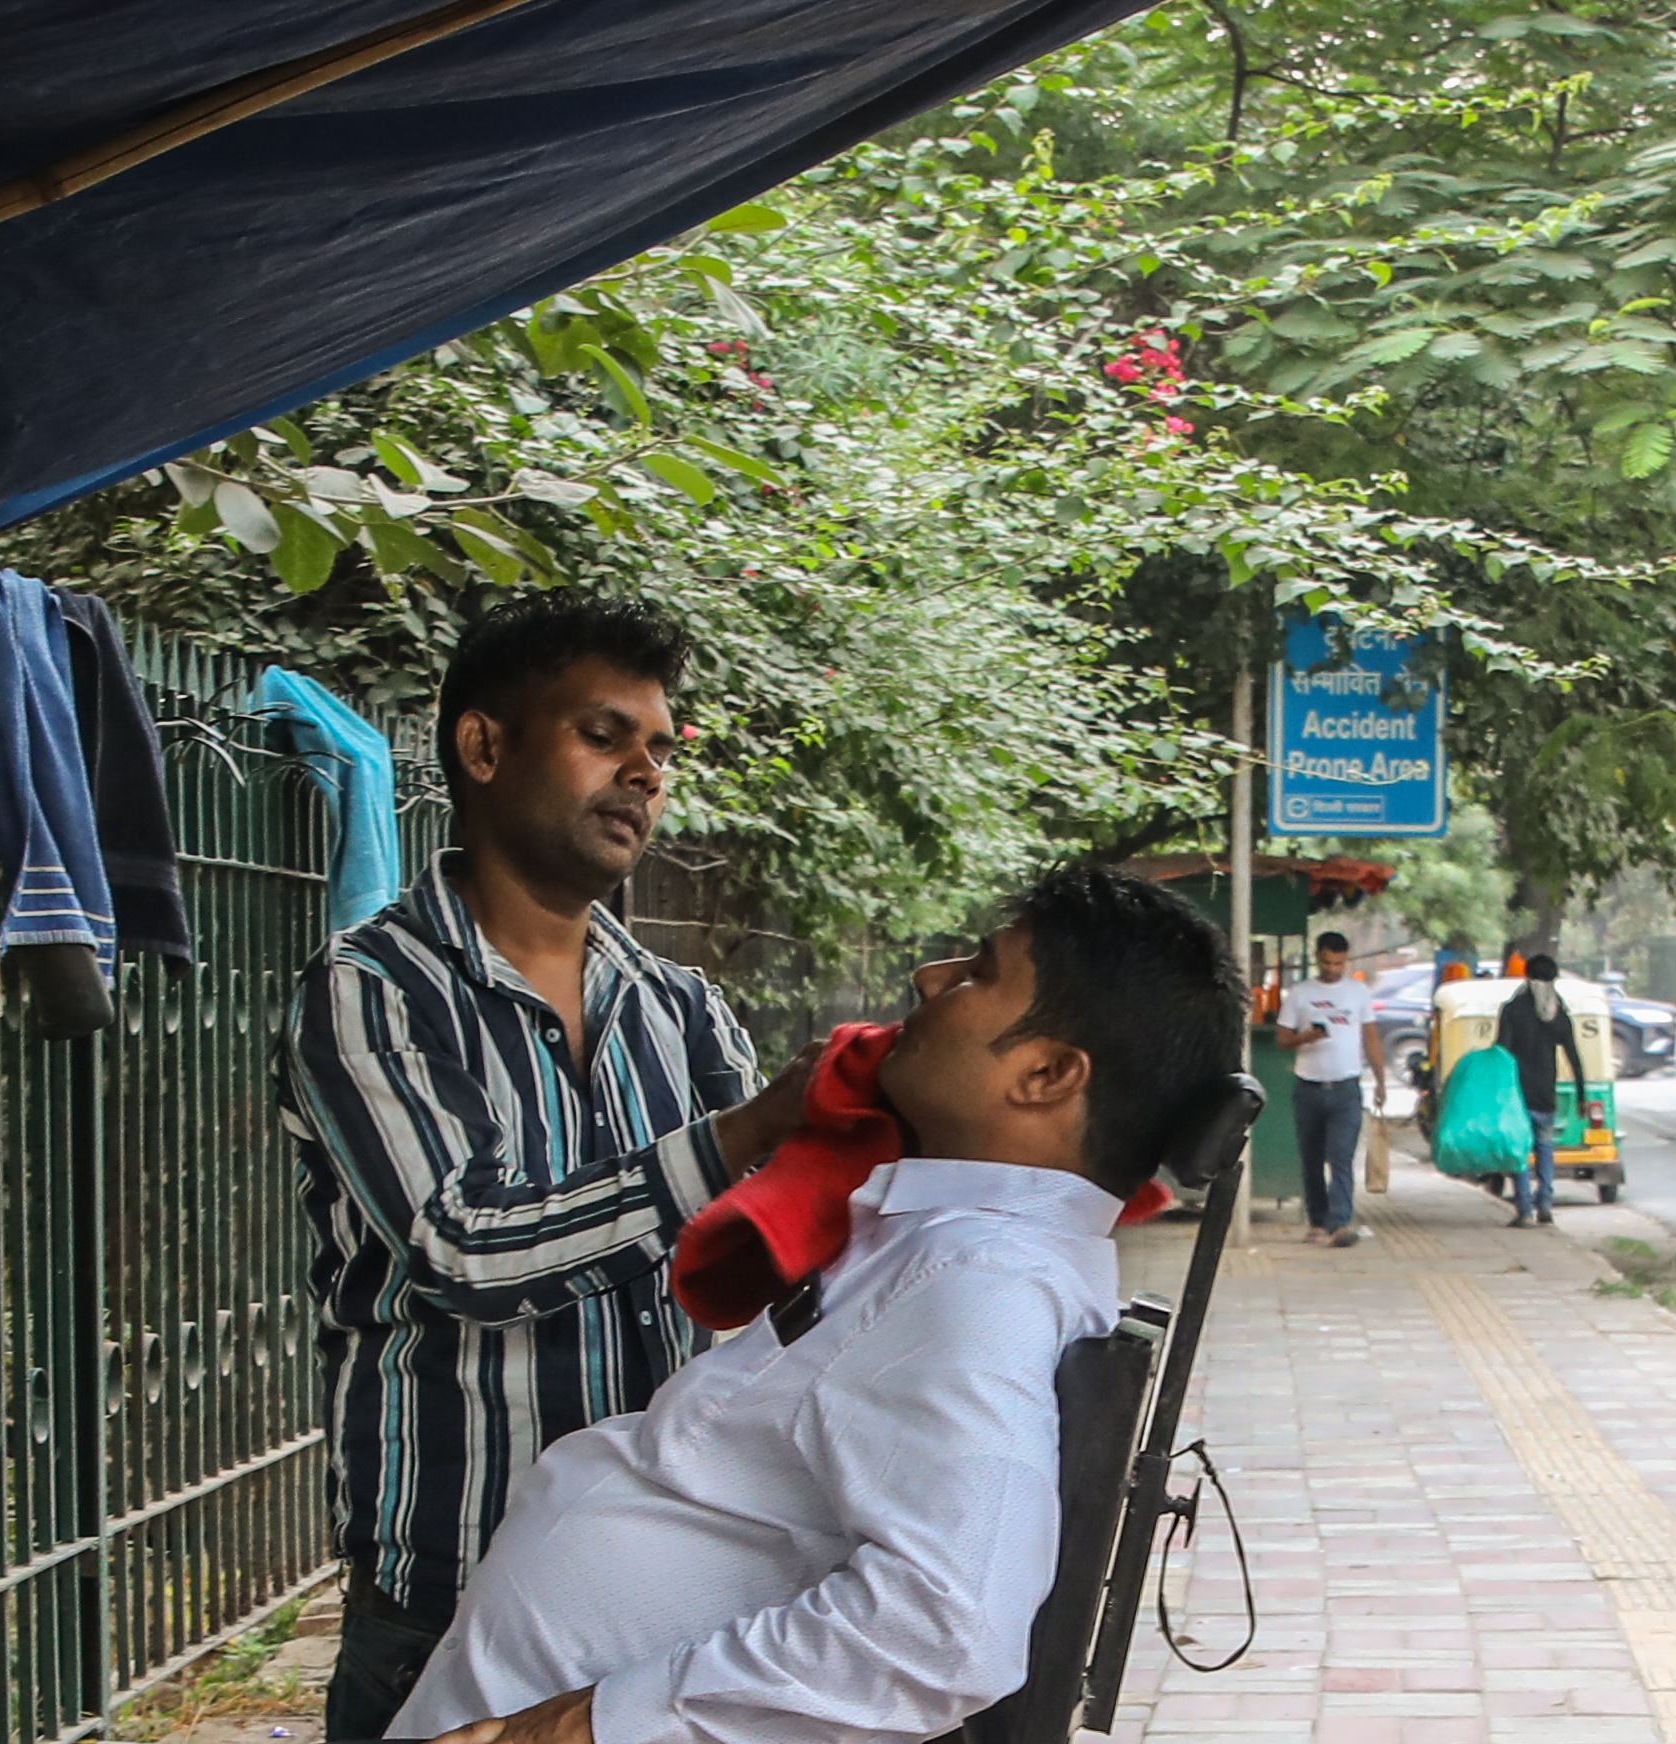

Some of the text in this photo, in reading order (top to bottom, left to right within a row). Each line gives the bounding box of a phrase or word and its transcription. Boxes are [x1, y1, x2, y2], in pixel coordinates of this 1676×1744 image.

[1301, 710, 1417, 740] Accident
[1287, 751, 1430, 782] Prone Area
[1580, 1018, 1600, 1039] S
